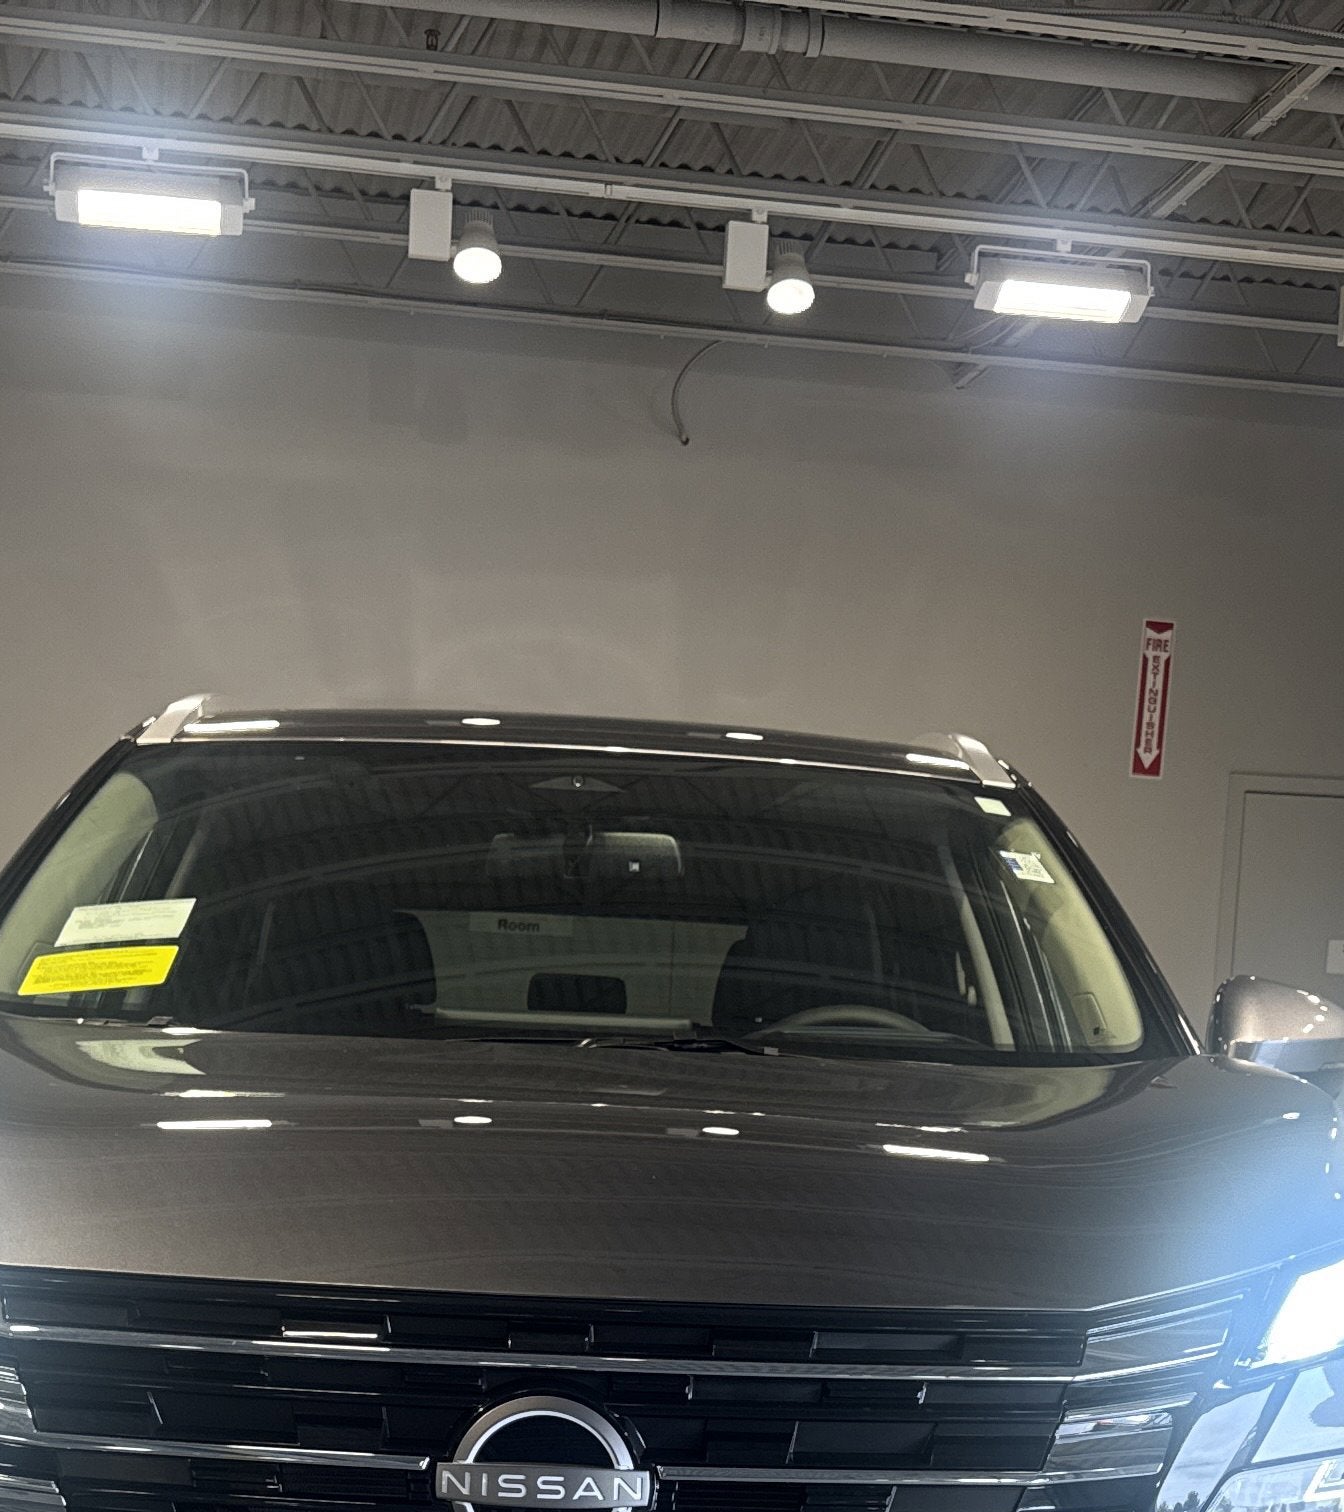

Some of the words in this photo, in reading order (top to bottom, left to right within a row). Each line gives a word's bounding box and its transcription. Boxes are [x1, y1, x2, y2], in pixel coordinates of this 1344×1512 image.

[1146, 638, 1169, 653] FIRE
[1144, 655, 1160, 754] EXTINGUISHER
[497, 918, 540, 933] Room
[441, 1470, 643, 1501] NISSAN
